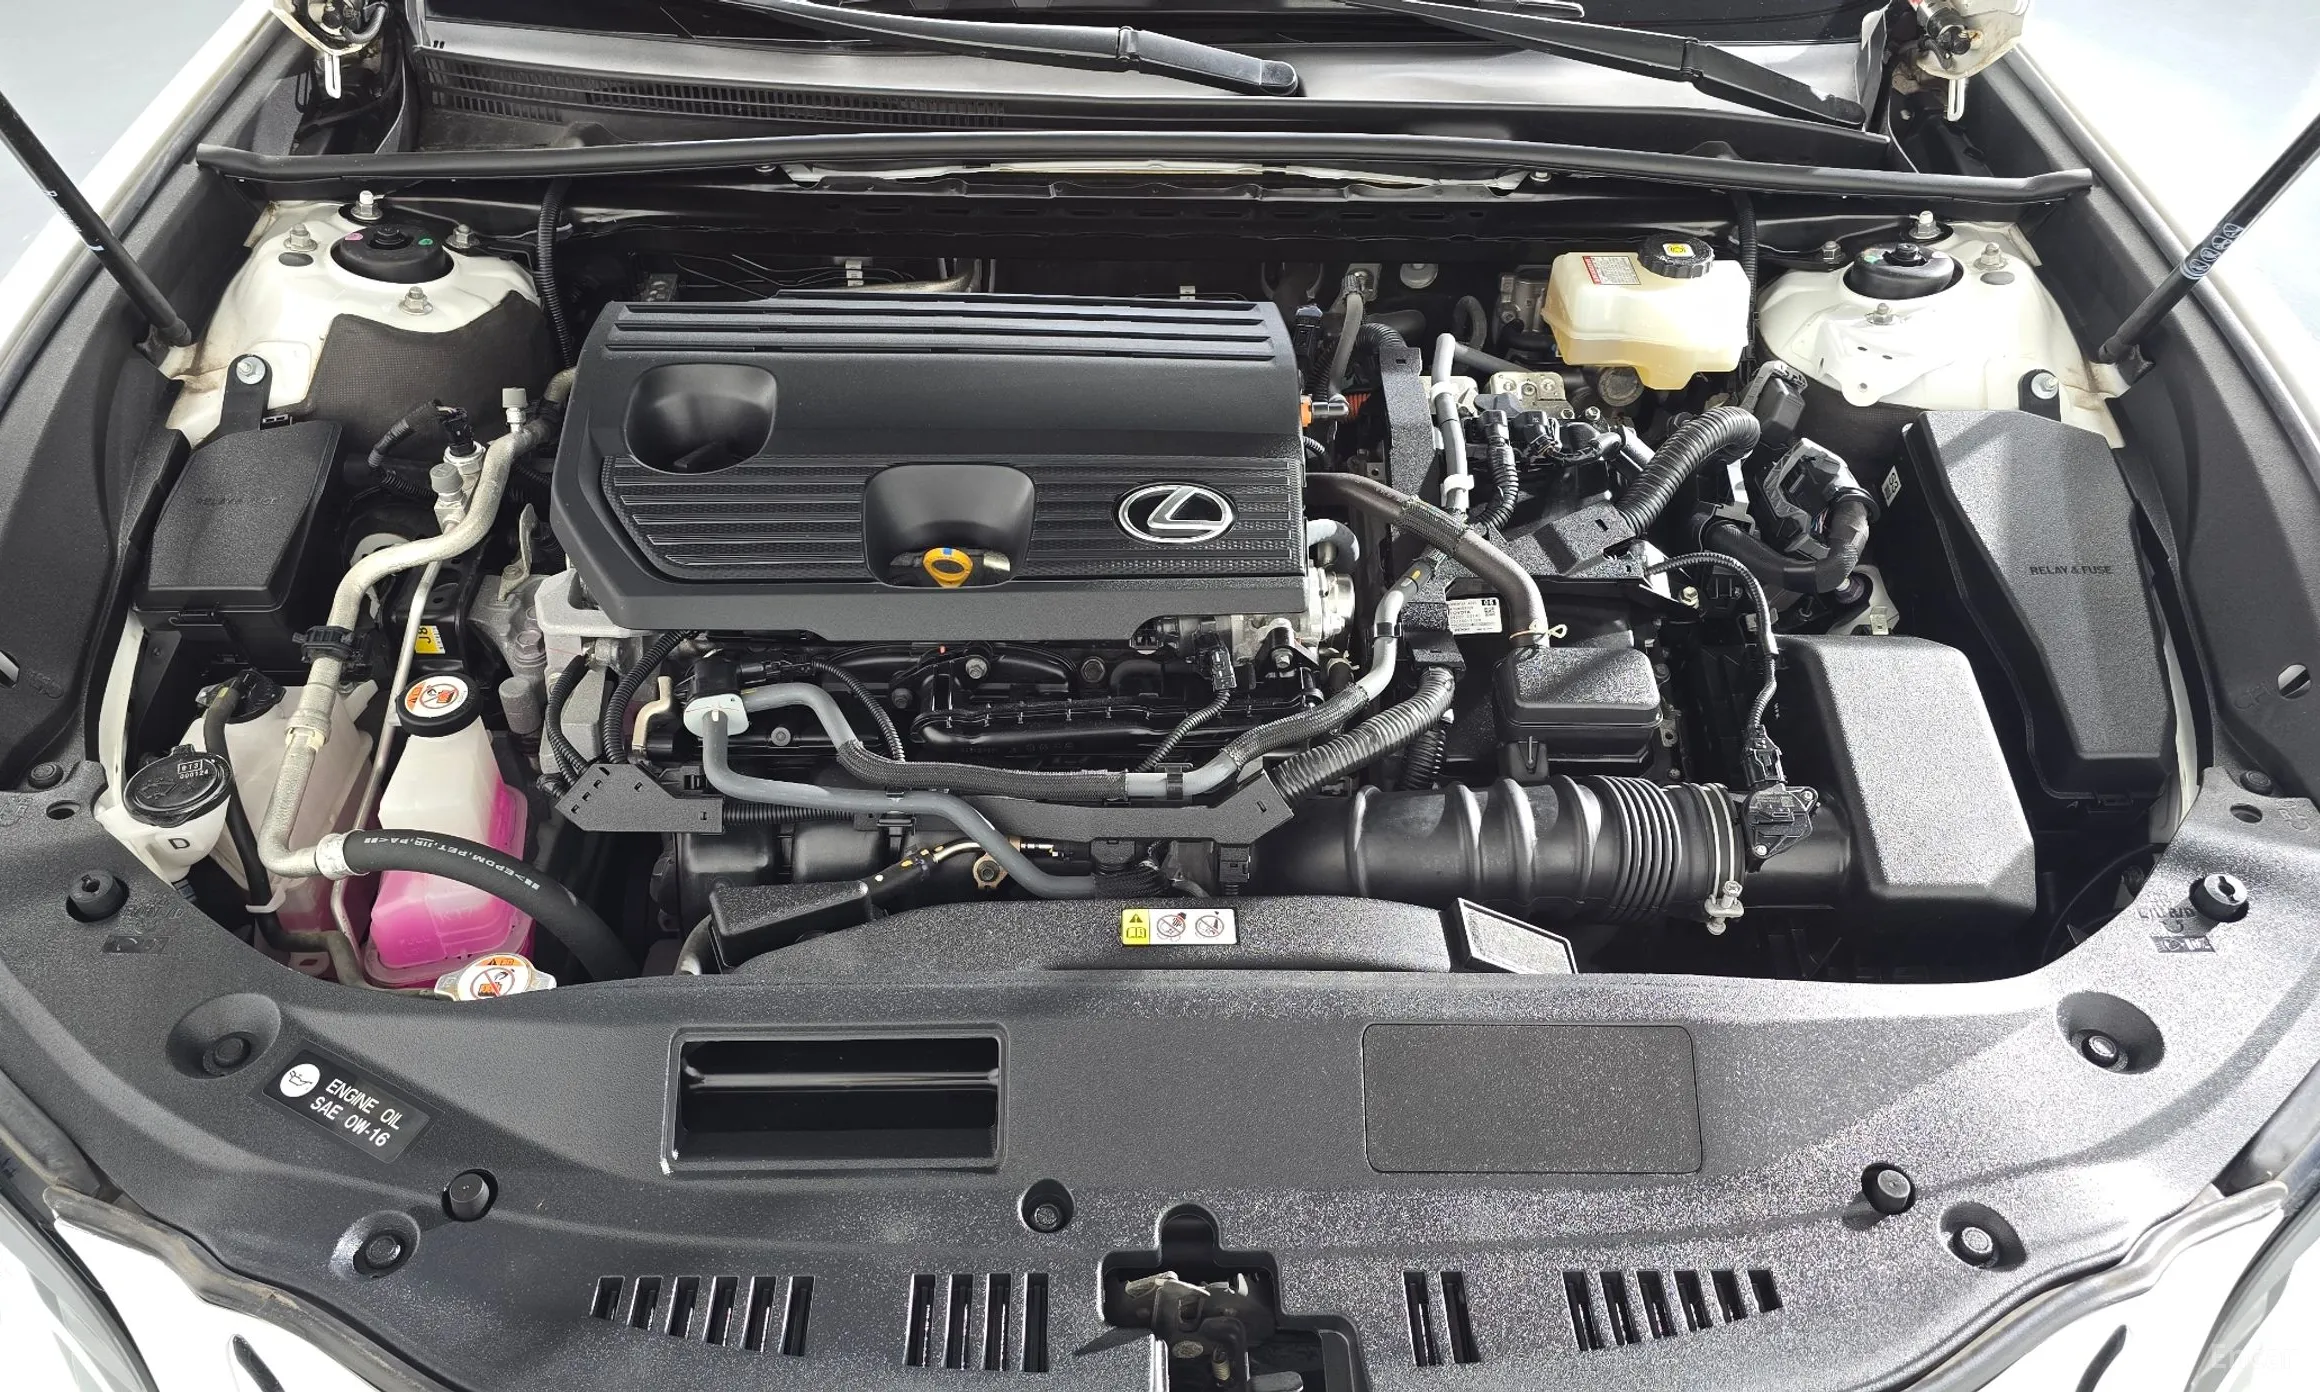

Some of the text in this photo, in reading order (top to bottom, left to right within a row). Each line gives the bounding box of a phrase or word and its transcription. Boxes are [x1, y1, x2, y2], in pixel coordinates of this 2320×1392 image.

[2029, 565, 2114, 576] RELAY & FUSE
[168, 838, 190, 850] D
[325, 1078, 403, 1130] ENGINE OIL
[310, 1096, 391, 1147] SAE 0W-16
